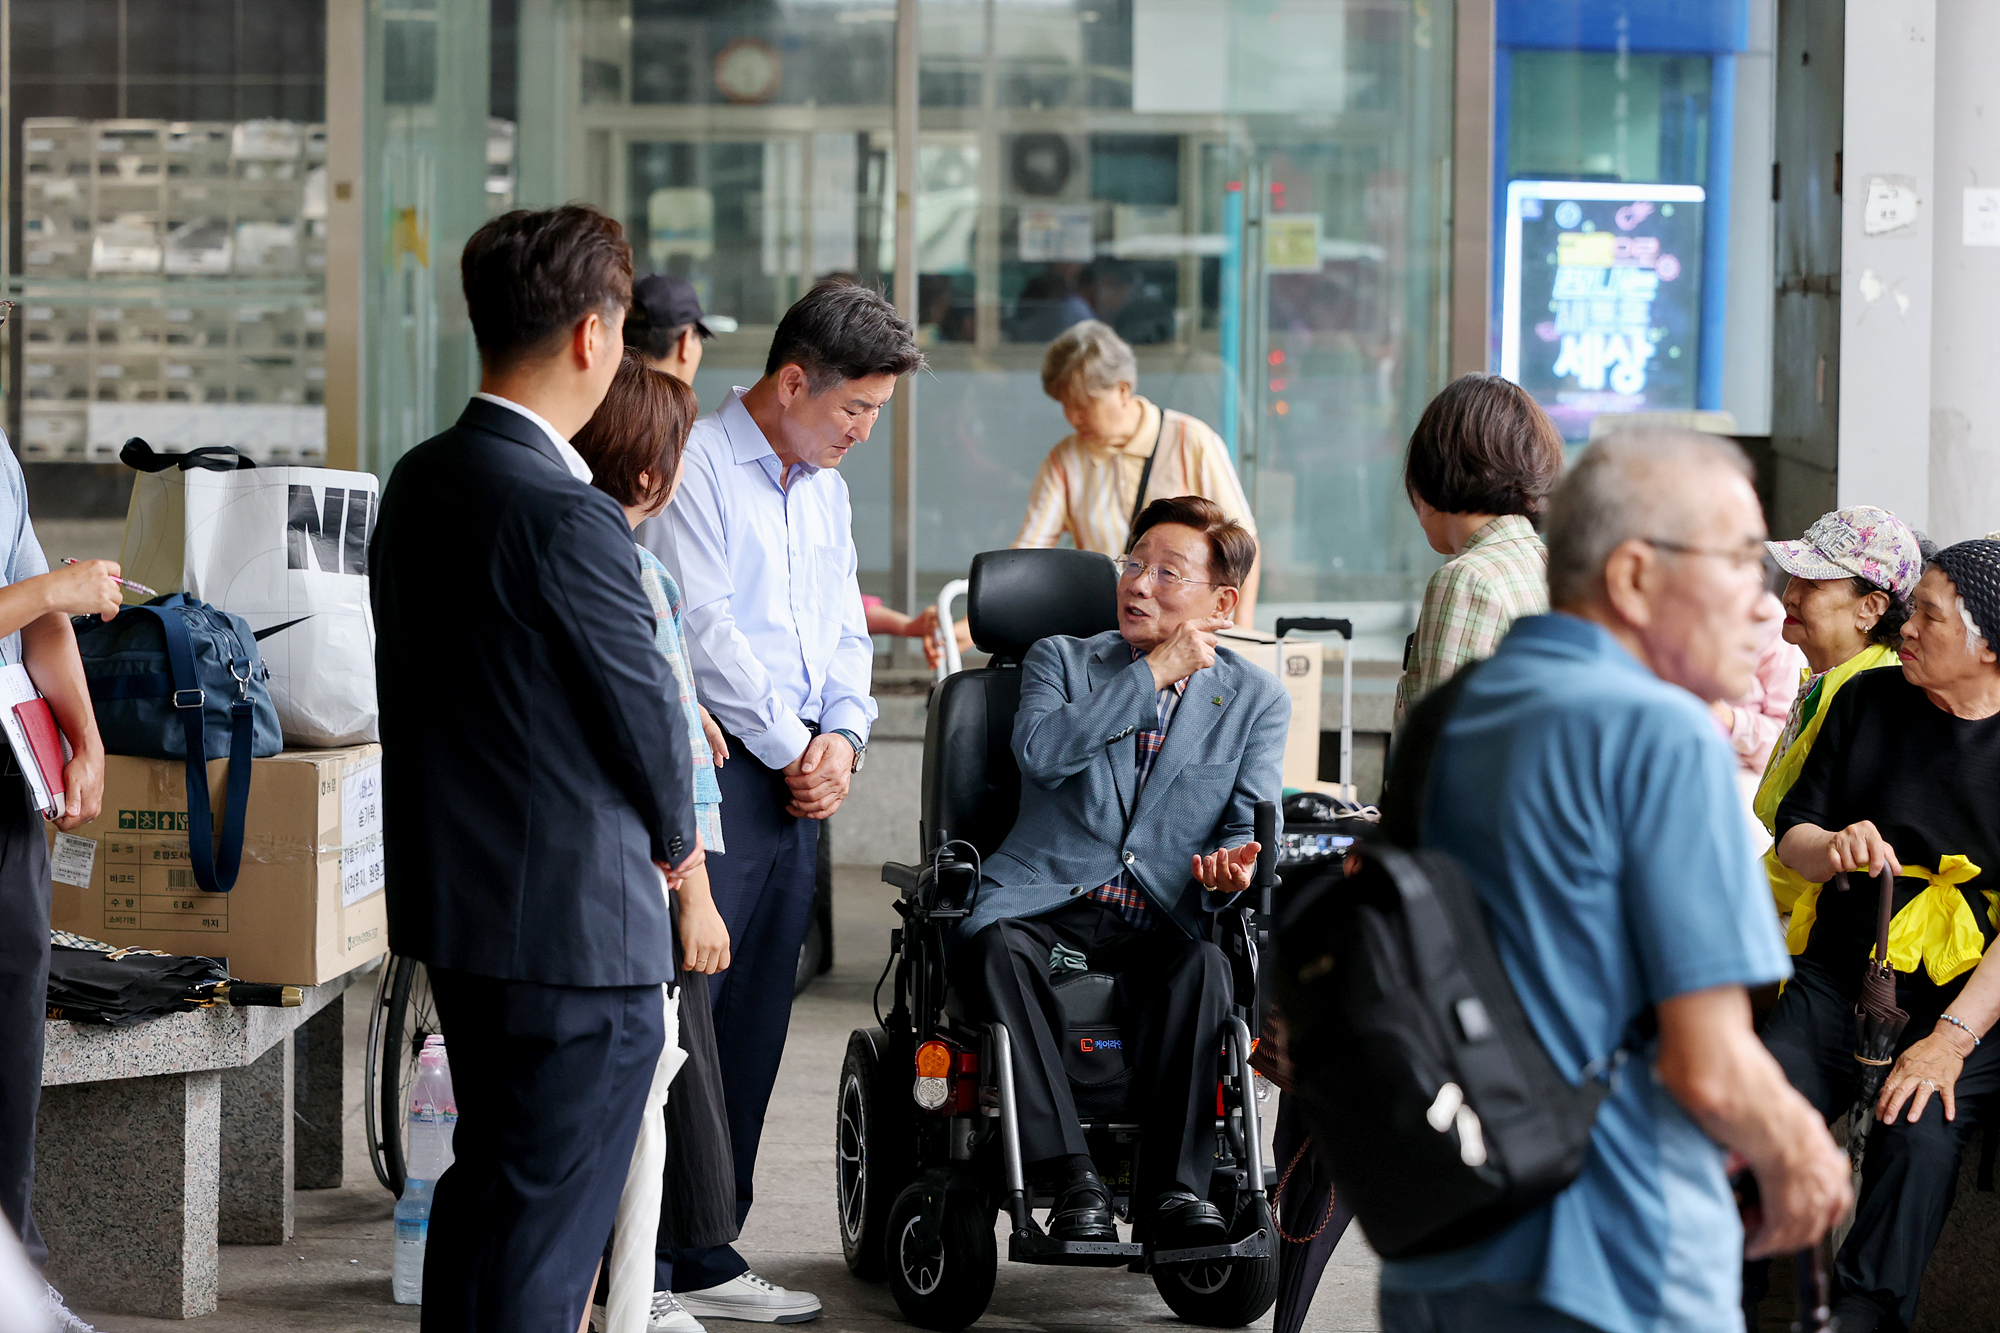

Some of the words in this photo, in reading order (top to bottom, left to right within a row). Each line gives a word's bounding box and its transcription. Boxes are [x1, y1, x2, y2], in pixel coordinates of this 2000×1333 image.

[1553, 332, 1657, 394] 세상
[110, 874, 136, 883] 바코드
[111, 898, 120, 908] 수
[125, 898, 134, 908] 량
[173, 901, 179, 909] 6
[182, 901, 195, 909] EA
[109, 916, 136, 924] 소비기한
[202, 919, 219, 928] 까지
